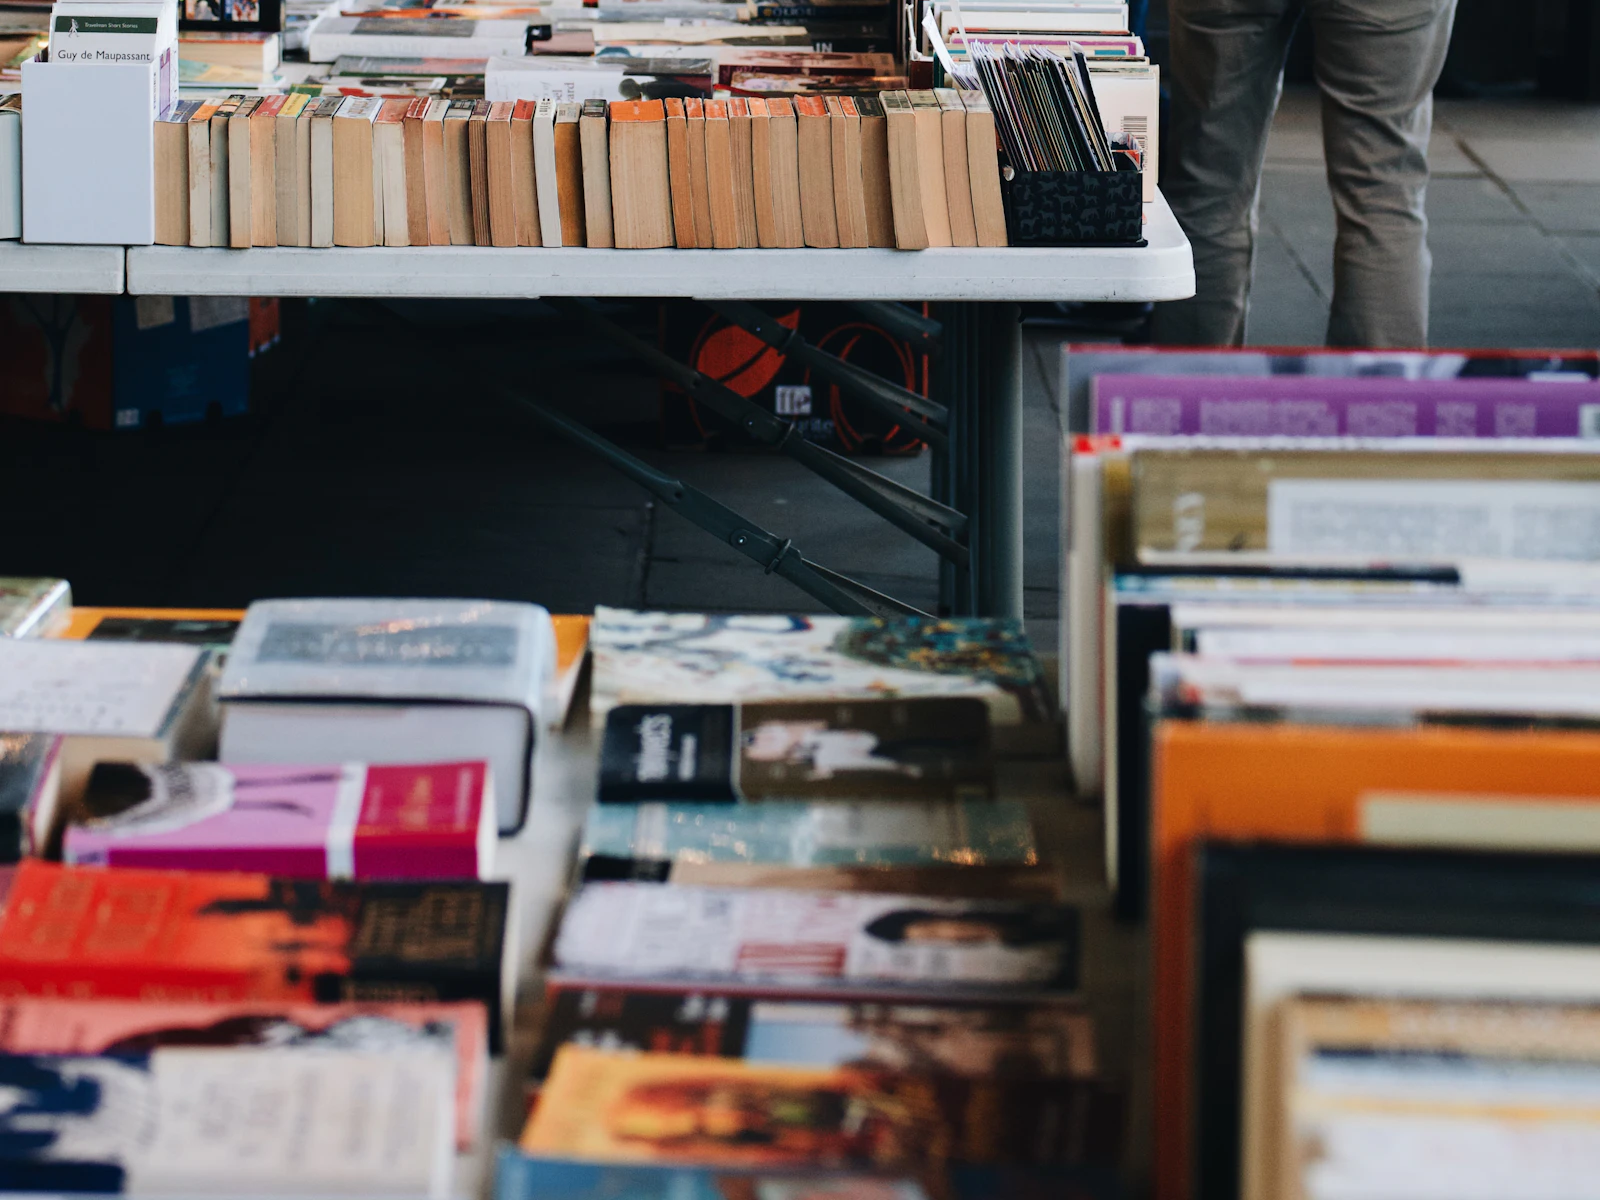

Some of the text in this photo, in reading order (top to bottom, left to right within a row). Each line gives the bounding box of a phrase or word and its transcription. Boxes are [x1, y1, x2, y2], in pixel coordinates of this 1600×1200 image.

[58, 49, 151, 62] Guy de Maupassant
